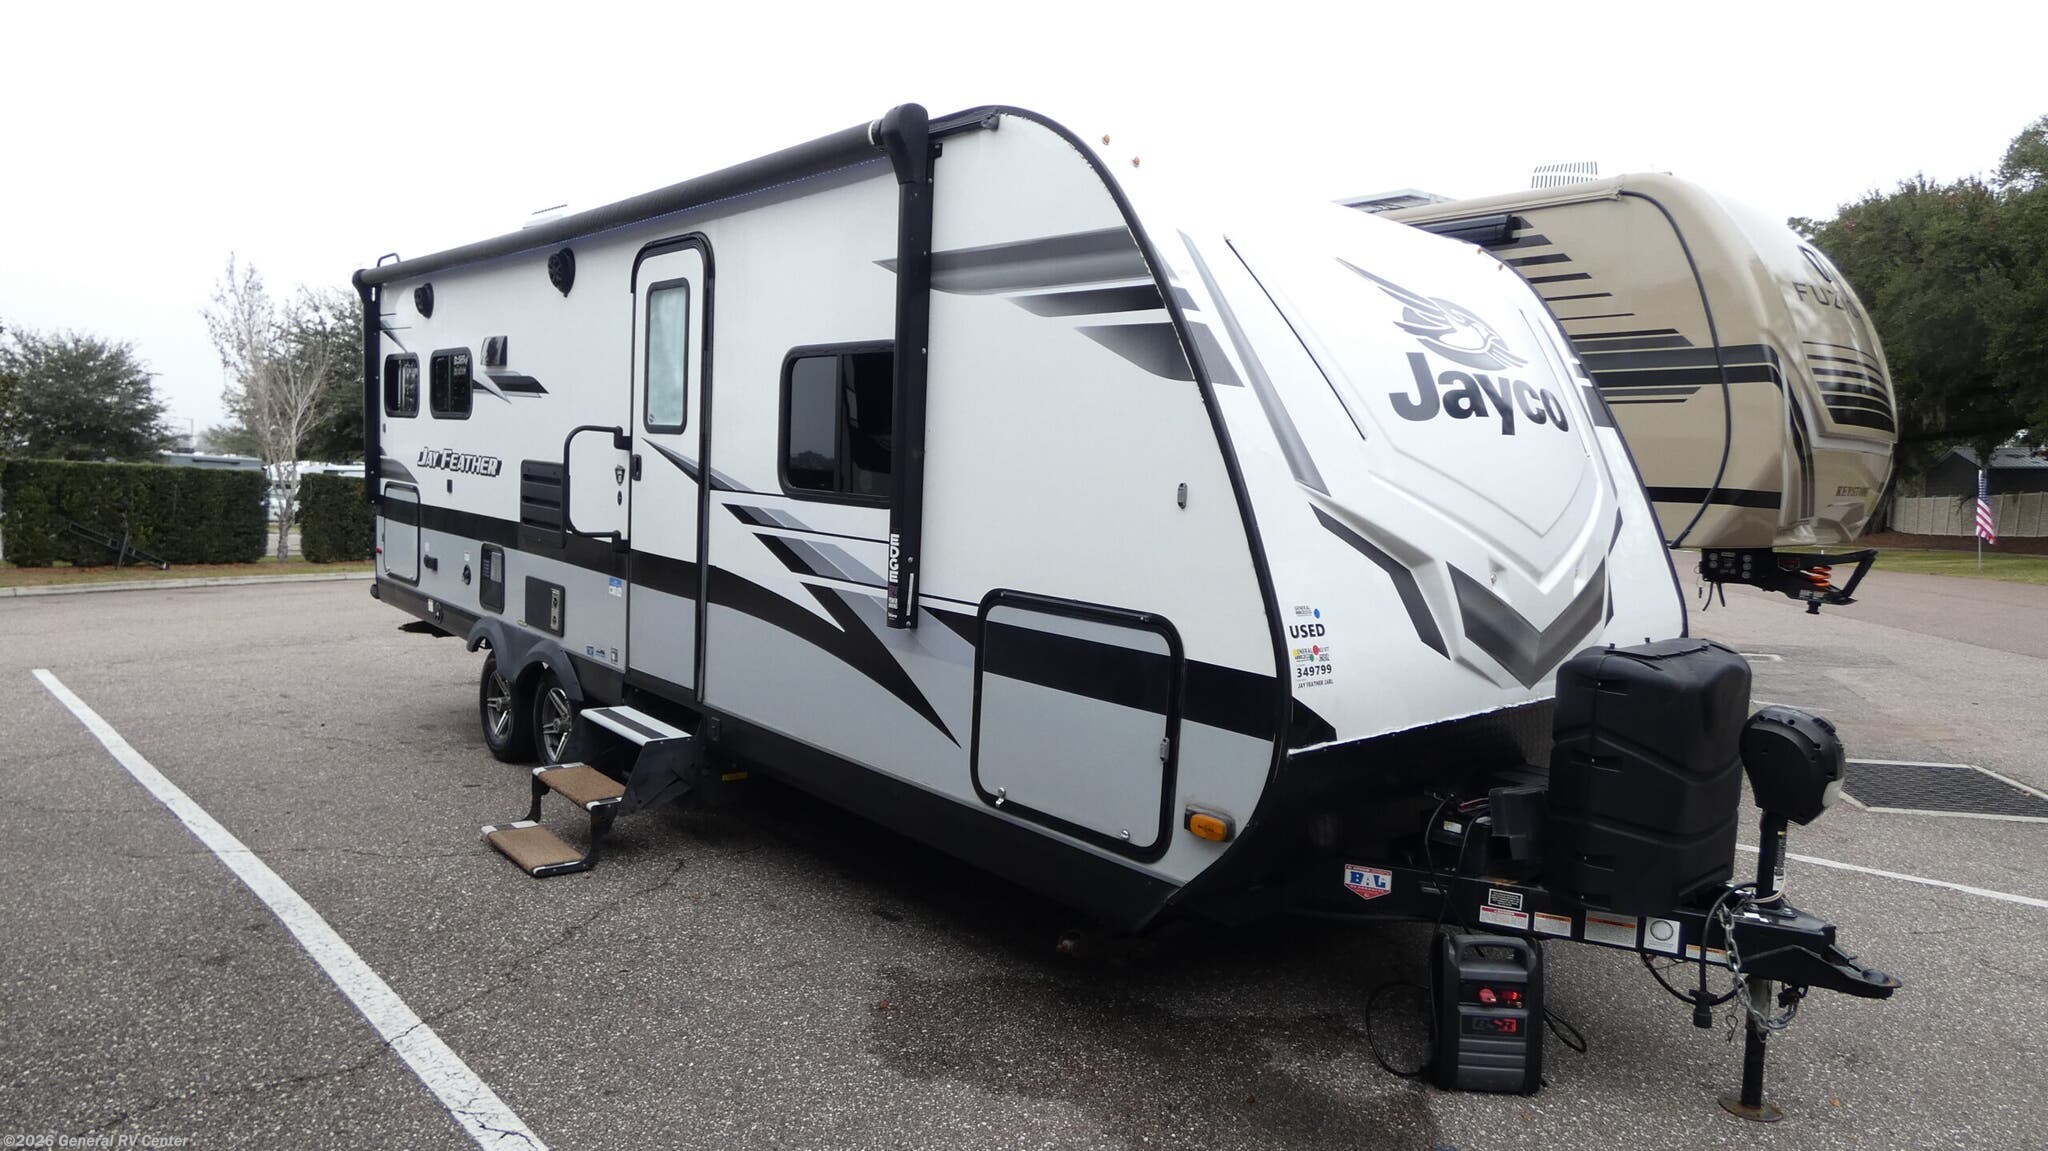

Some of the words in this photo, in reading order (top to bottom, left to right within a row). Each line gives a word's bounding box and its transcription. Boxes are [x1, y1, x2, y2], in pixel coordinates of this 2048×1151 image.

[1388, 352, 1569, 436] Jayco
[417, 446, 441, 468] JAY
[440, 448, 502, 477] FEATHER
[889, 533, 900, 583] EDGE
[1289, 624, 1325, 638] USED
[1297, 664, 1332, 678] 349799
